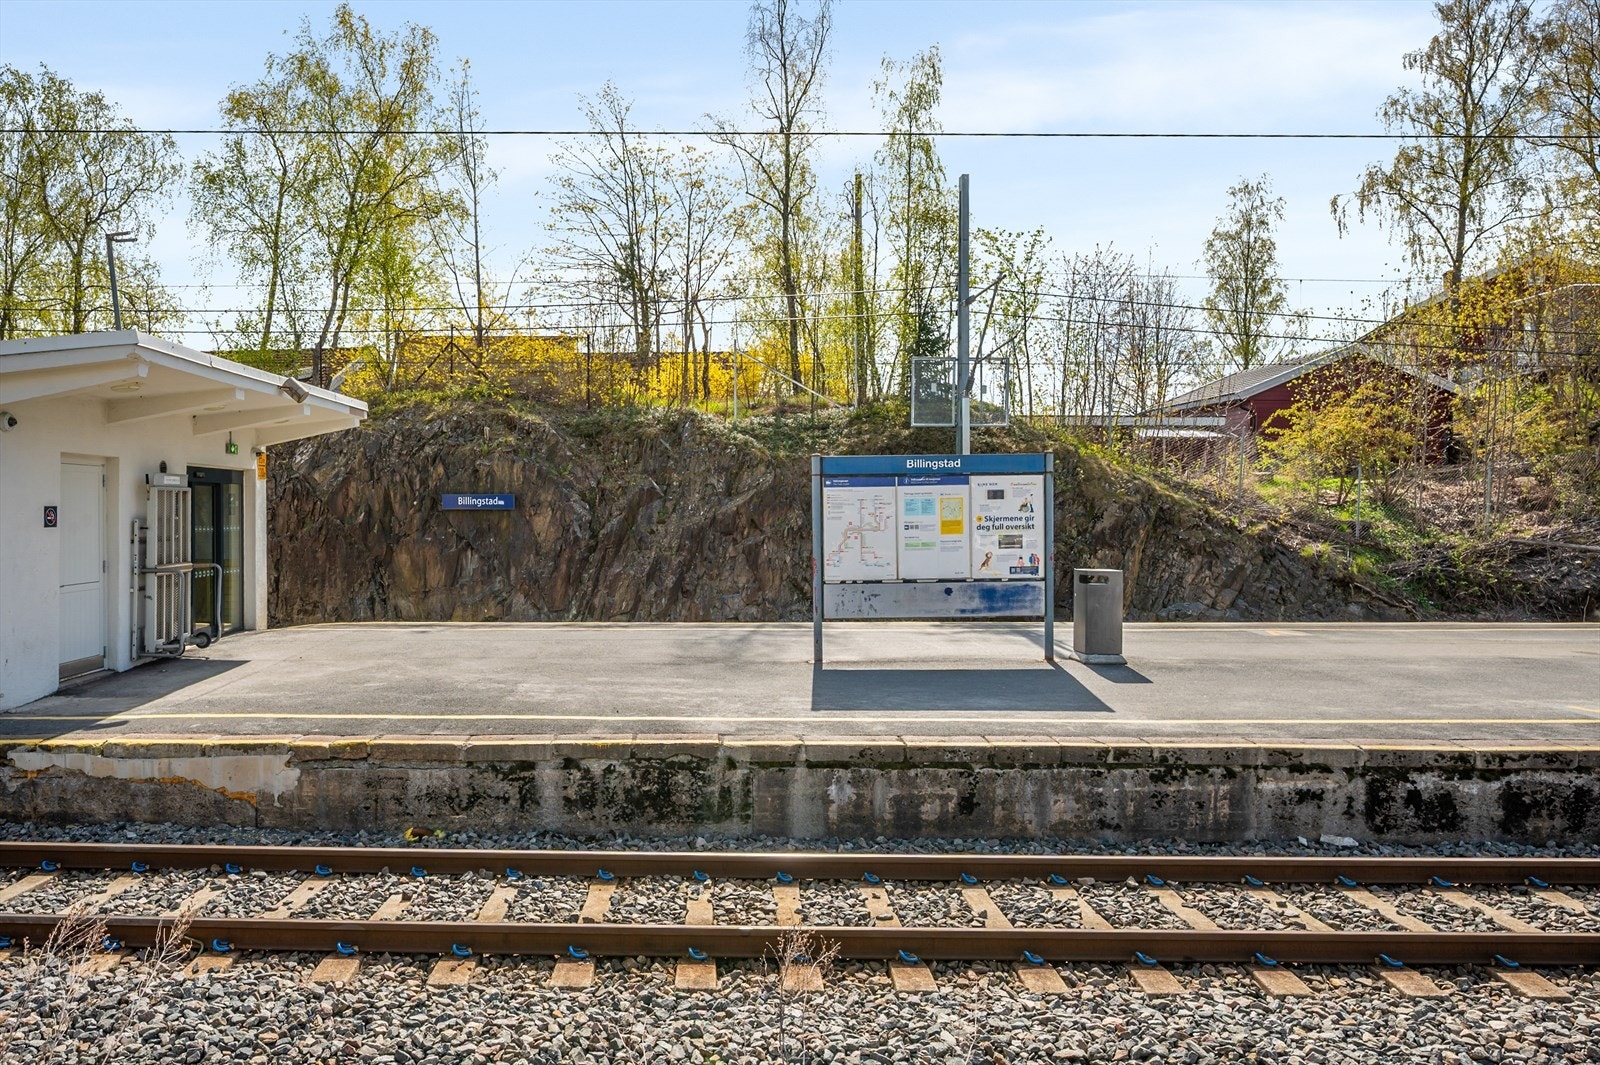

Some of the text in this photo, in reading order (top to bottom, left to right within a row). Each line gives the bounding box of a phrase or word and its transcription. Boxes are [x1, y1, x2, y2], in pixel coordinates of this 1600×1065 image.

[906, 459, 961, 470] Billingstad
[458, 497, 499, 507] Billingstad
[984, 514, 1035, 523] Skjermene gir
